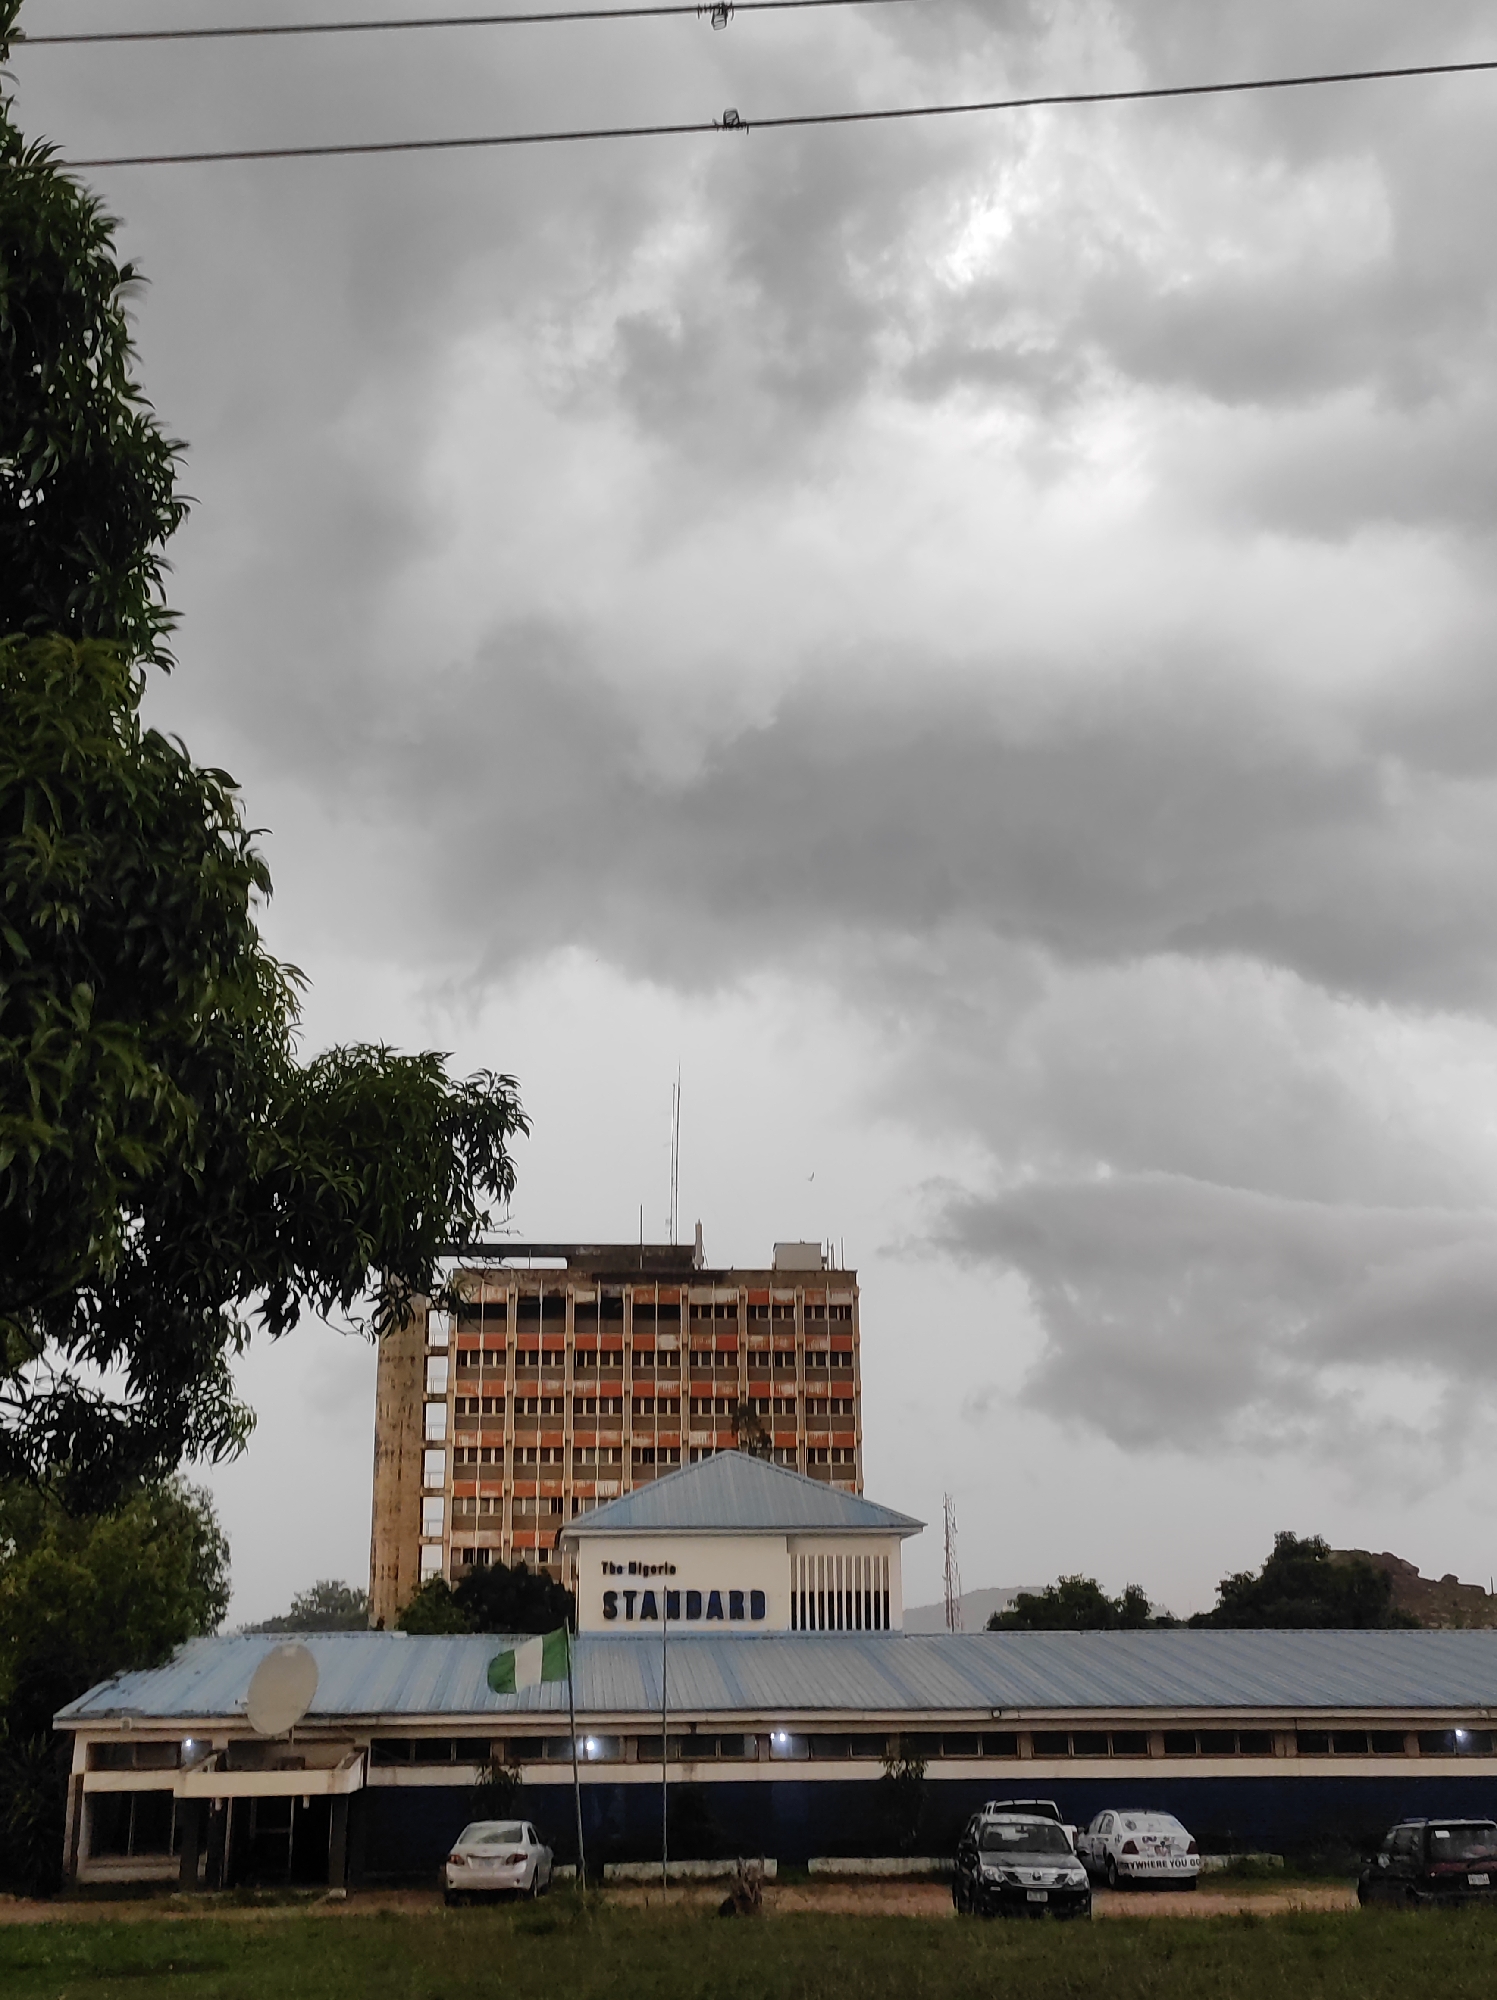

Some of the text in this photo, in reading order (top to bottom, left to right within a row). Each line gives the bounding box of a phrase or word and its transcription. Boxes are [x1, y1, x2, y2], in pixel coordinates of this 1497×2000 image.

[601, 1561, 677, 1578] The Nigeria
[602, 1590, 766, 1620] STANDARD
[1169, 1858, 1187, 1868] YOU
